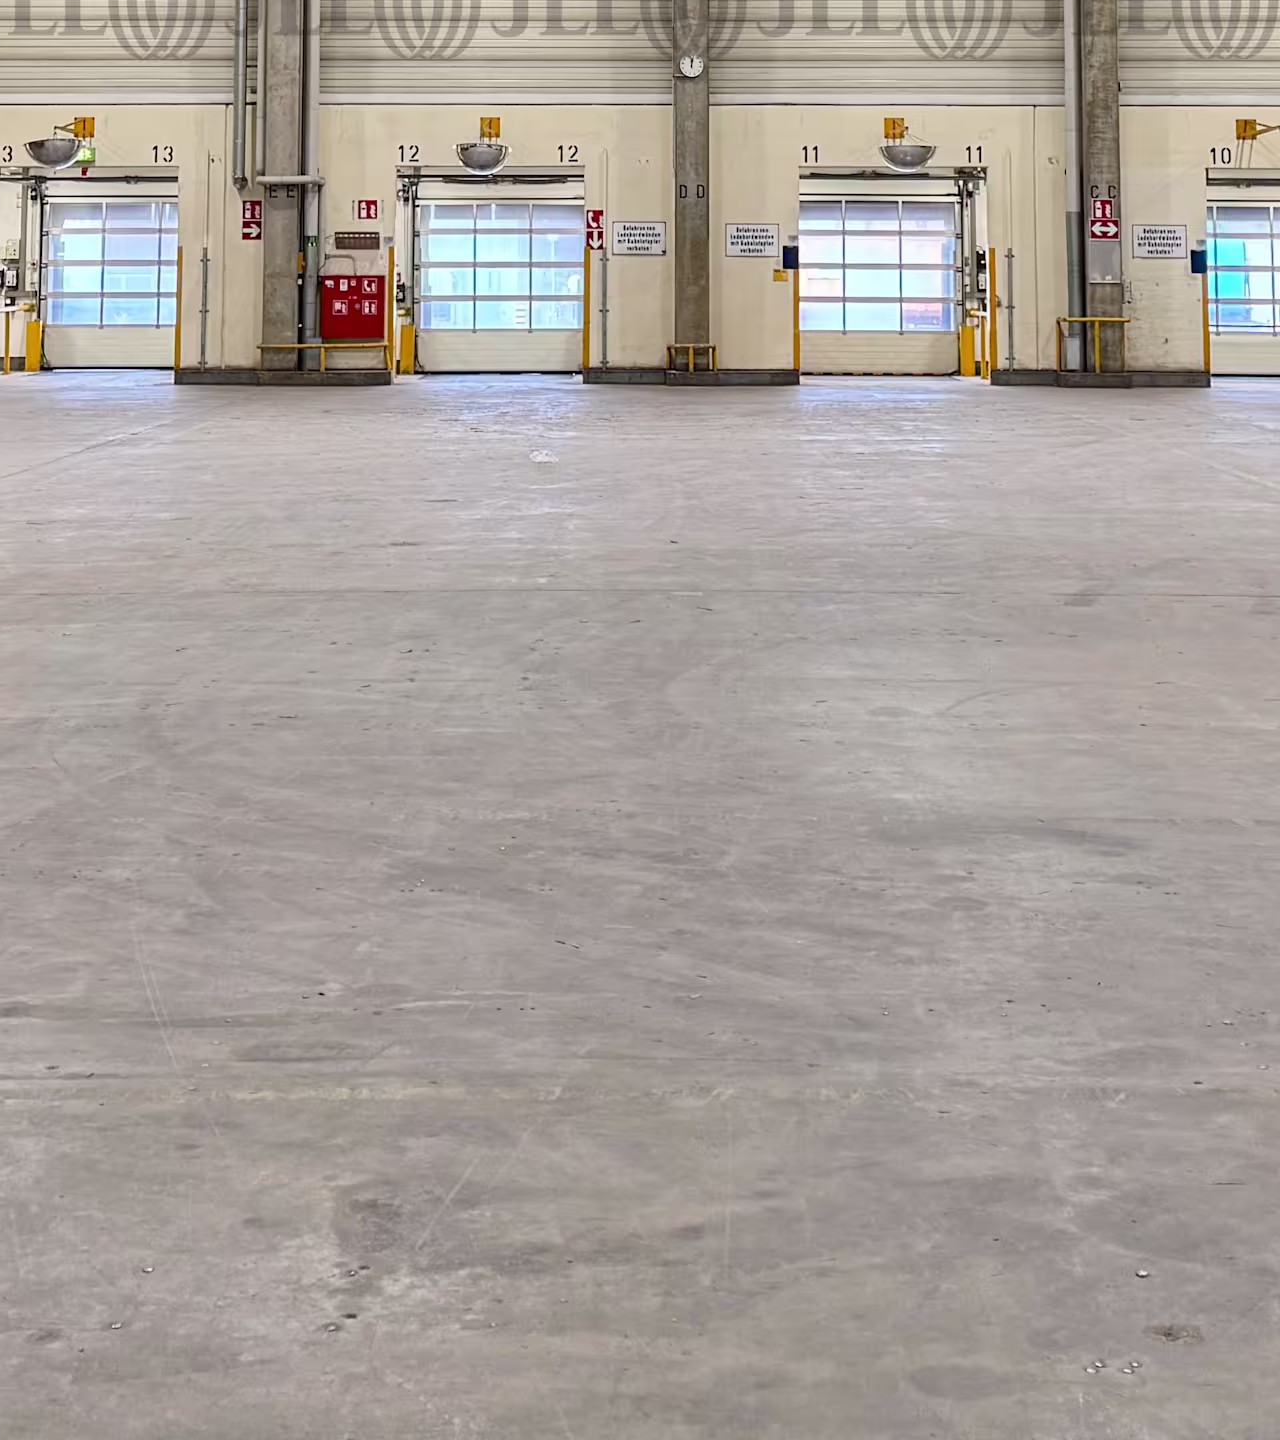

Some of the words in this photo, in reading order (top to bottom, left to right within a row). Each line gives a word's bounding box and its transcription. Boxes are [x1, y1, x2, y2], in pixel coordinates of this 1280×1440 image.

[152, 145, 174, 163] 13
[398, 145, 419, 162] 12
[557, 145, 579, 162] 12
[802, 145, 818, 163] 11
[965, 145, 982, 163] 11
[1210, 147, 1232, 165] 10
[269, 184, 278, 198] E
[286, 184, 296, 198] E
[679, 184, 688, 199] D
[696, 184, 705, 199] D
[1090, 185, 1099, 199] C
[1108, 185, 1117, 199] C
